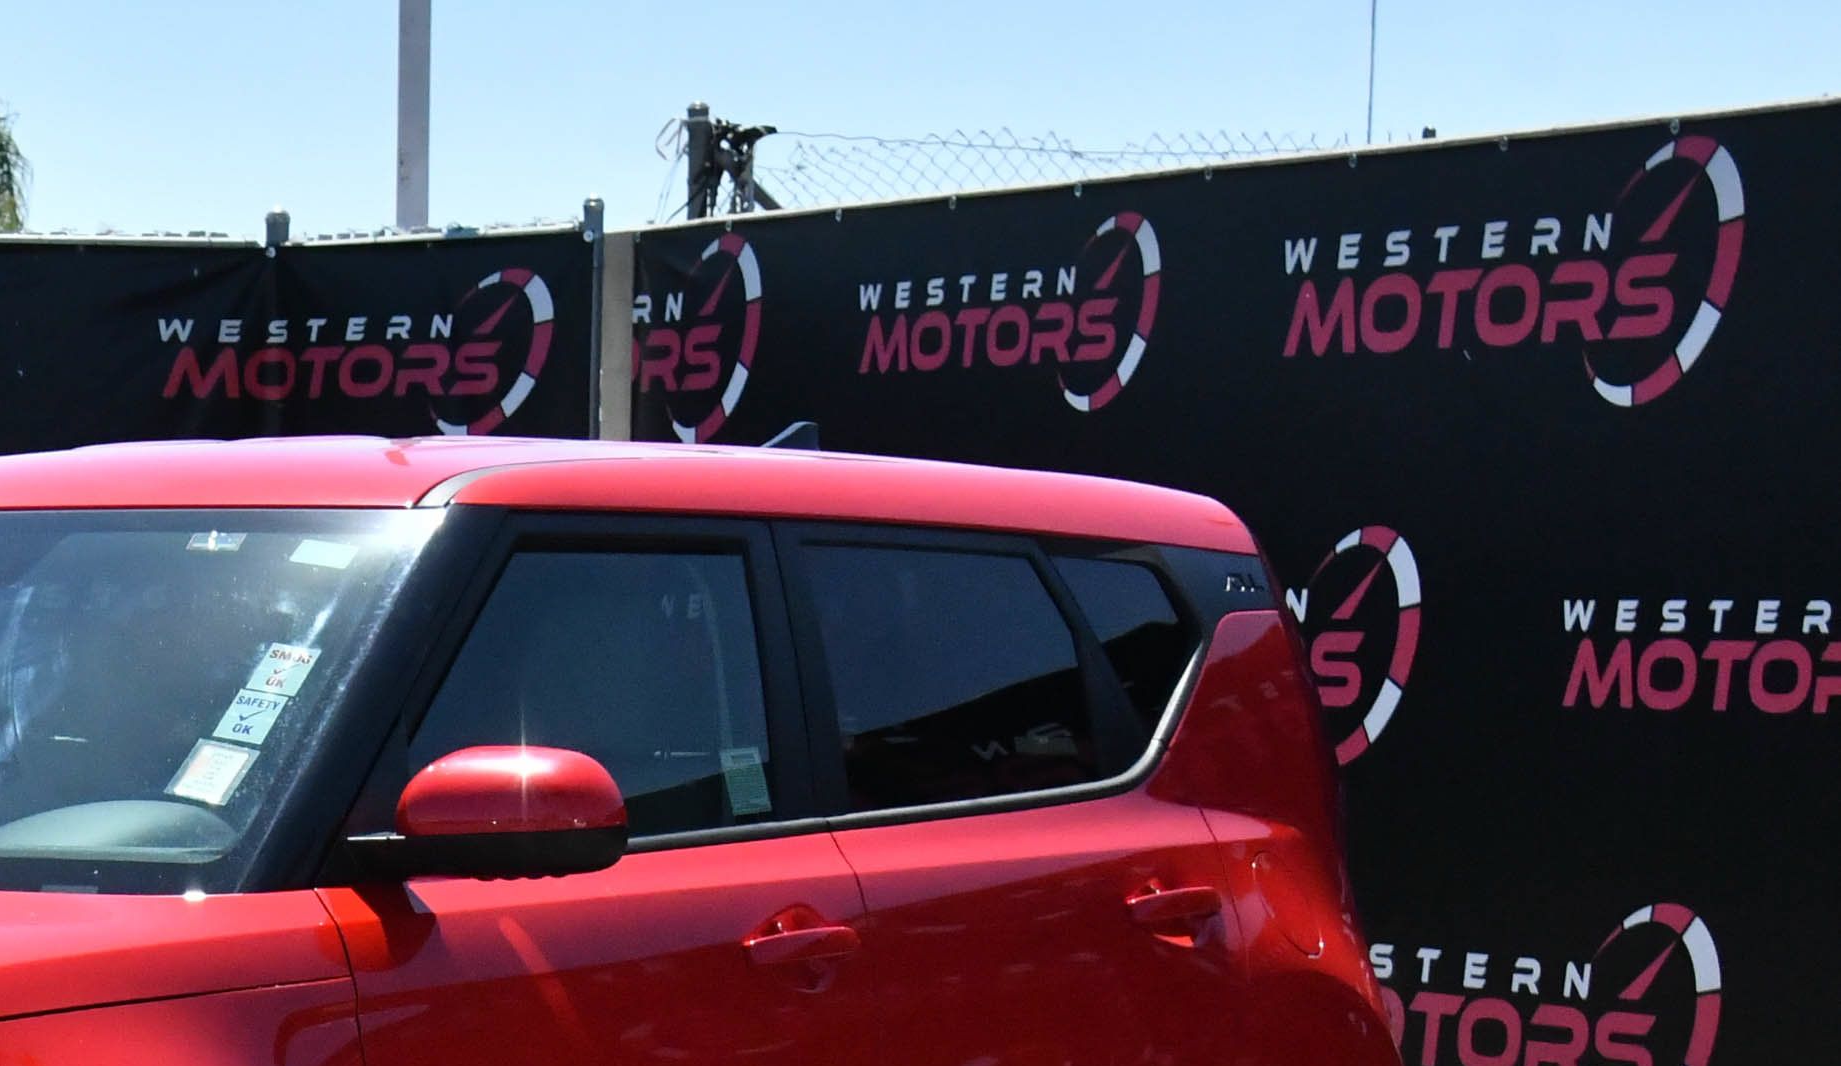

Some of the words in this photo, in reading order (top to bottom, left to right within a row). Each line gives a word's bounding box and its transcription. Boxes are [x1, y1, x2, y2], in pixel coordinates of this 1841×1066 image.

[1284, 212, 1613, 274] WESTERN
[859, 264, 1076, 311] WESTERN
[1282, 253, 1678, 357] MOTORS
[158, 313, 454, 344] WESTERN
[857, 296, 1118, 374] MOTORS
[162, 340, 502, 400] MOTORS
[236, 695, 281, 711] SAFETY
[265, 676, 286, 689] OK
[232, 723, 253, 735] OK
